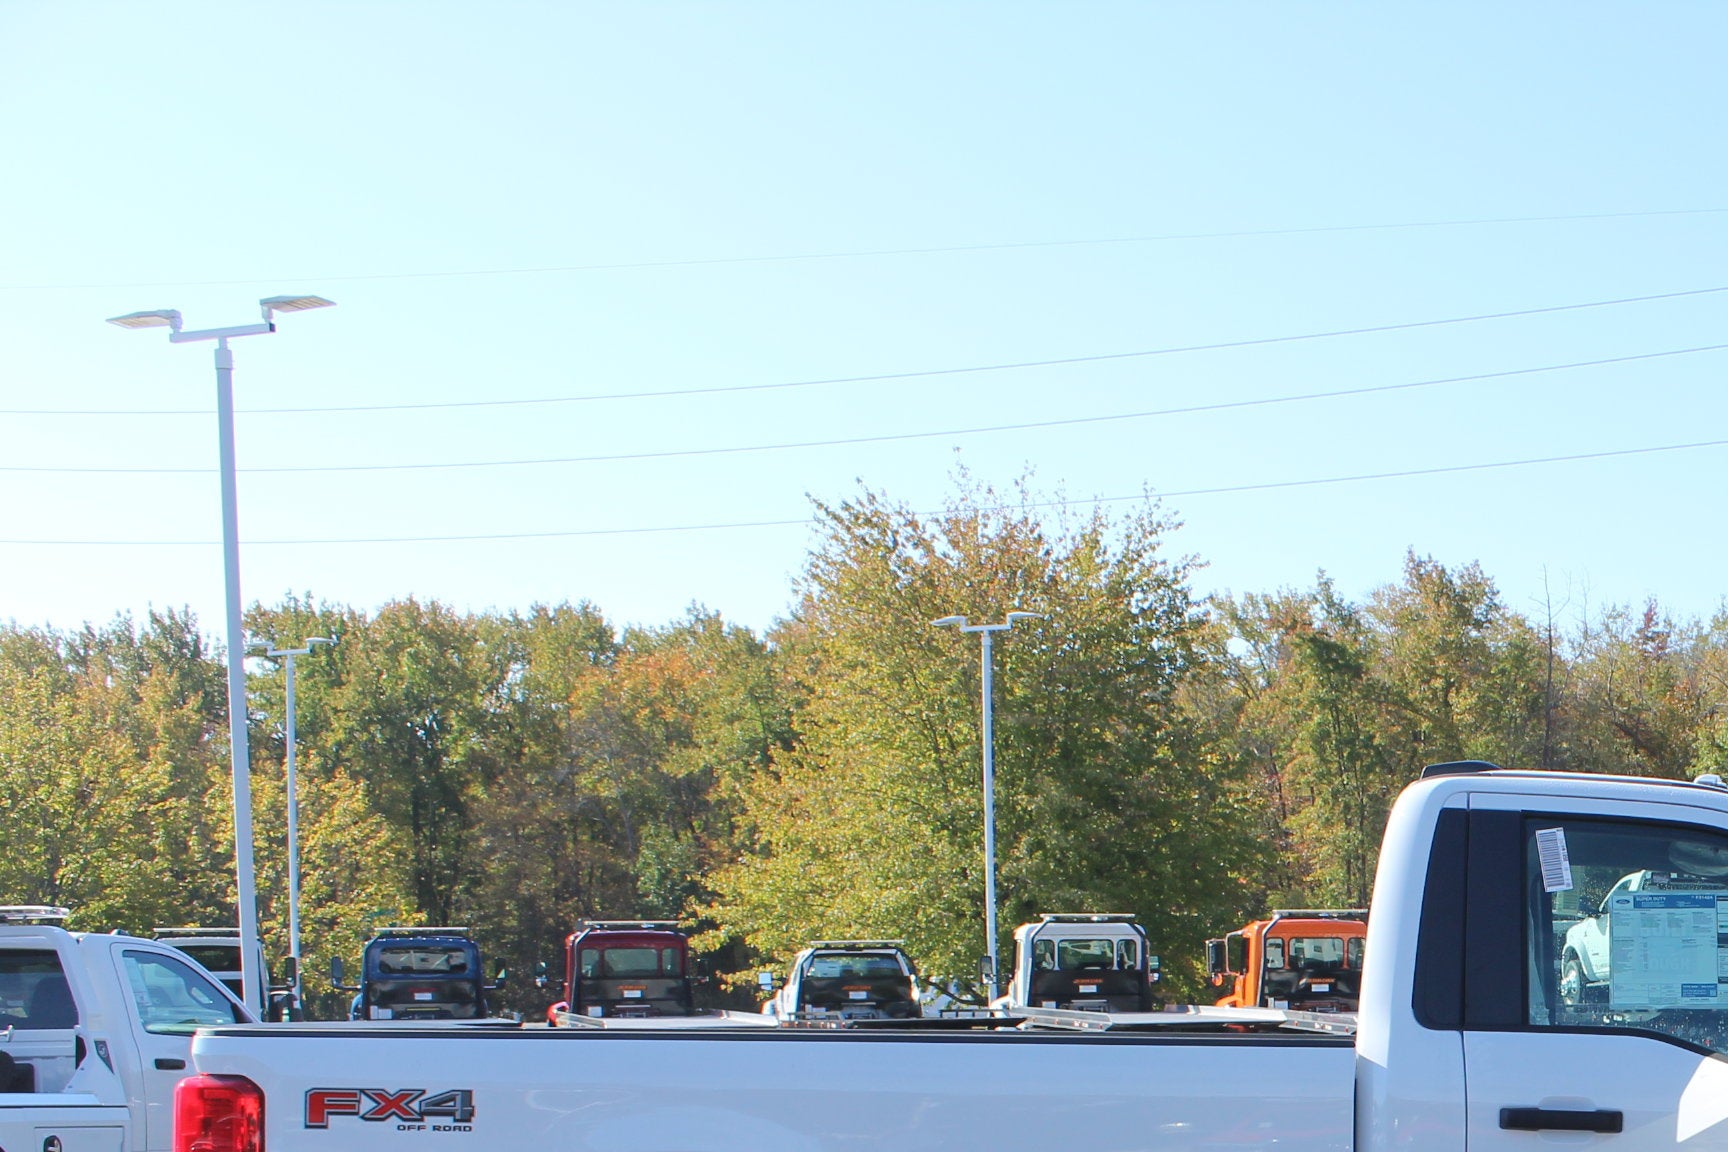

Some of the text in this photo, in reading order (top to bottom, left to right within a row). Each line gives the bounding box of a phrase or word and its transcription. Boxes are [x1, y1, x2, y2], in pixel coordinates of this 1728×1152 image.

[304, 1087, 475, 1129] FX4
[397, 1124, 473, 1132] OFF ROAD
